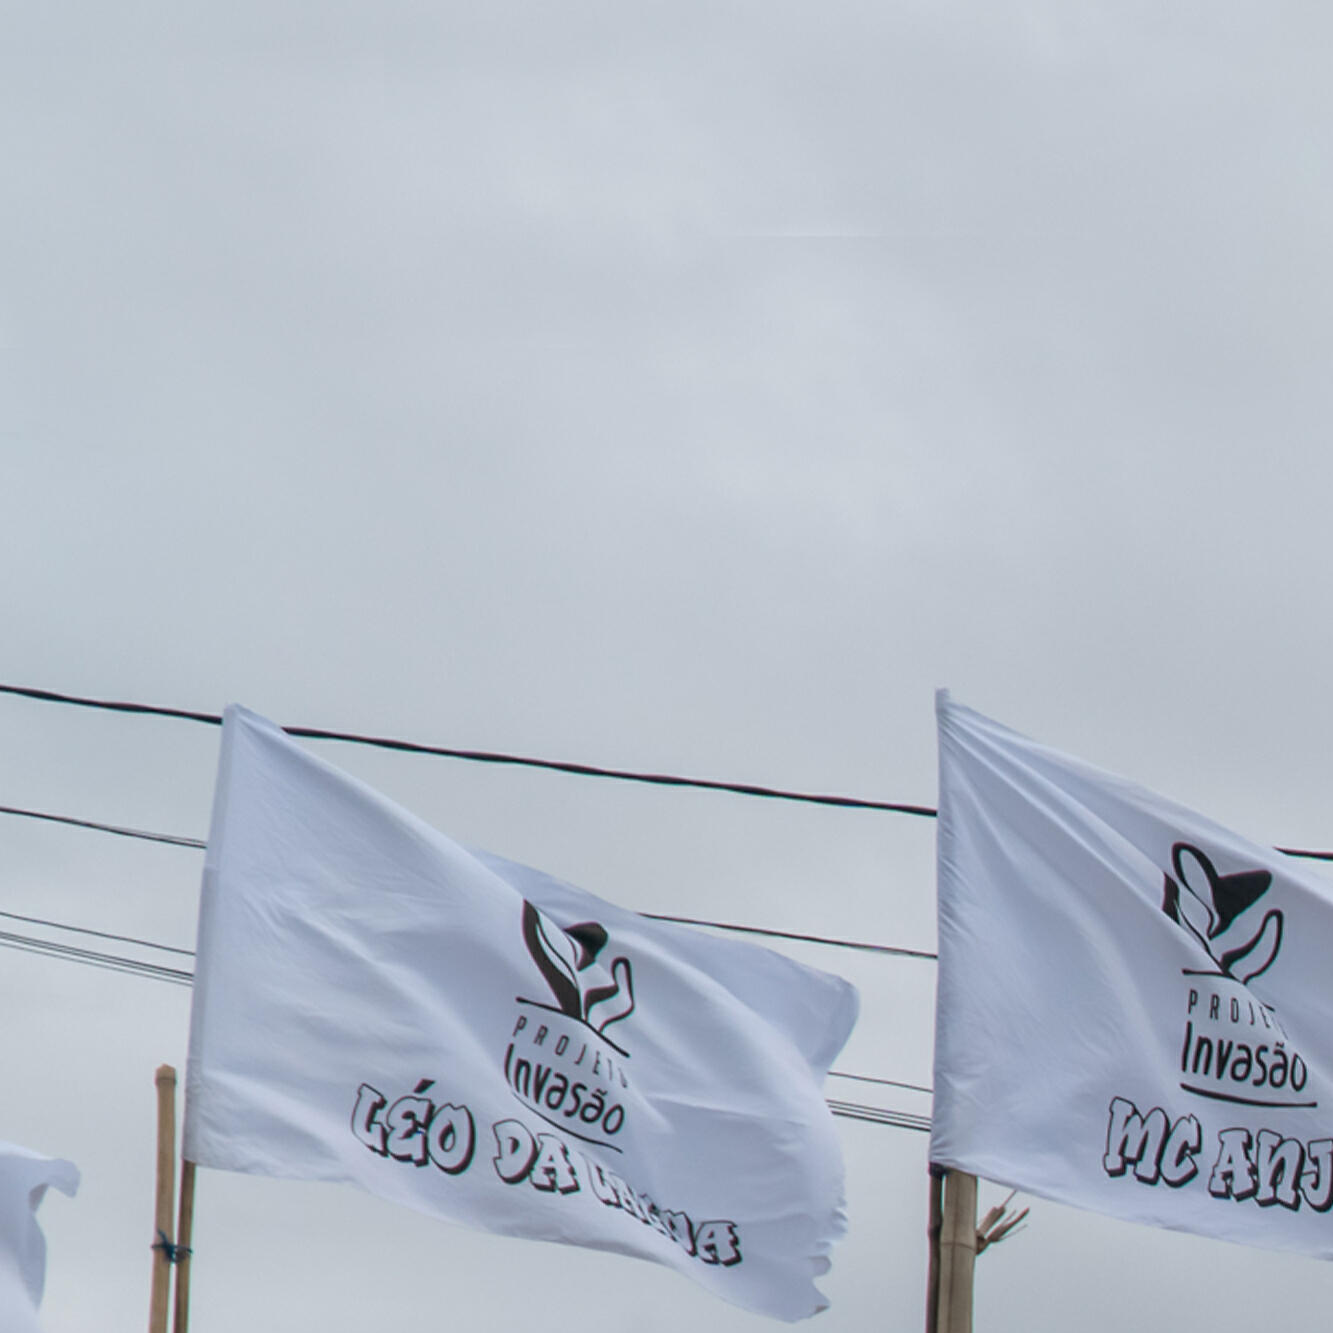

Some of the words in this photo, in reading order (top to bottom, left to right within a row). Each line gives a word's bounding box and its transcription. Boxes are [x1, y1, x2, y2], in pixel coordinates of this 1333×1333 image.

[503, 1043, 625, 1135] Invasão
[1180, 1020, 1308, 1092] Invasão
[351, 1077, 476, 1176] LÉO
[492, 1118, 581, 1195] DA
[1102, 1095, 1202, 1188] MC
